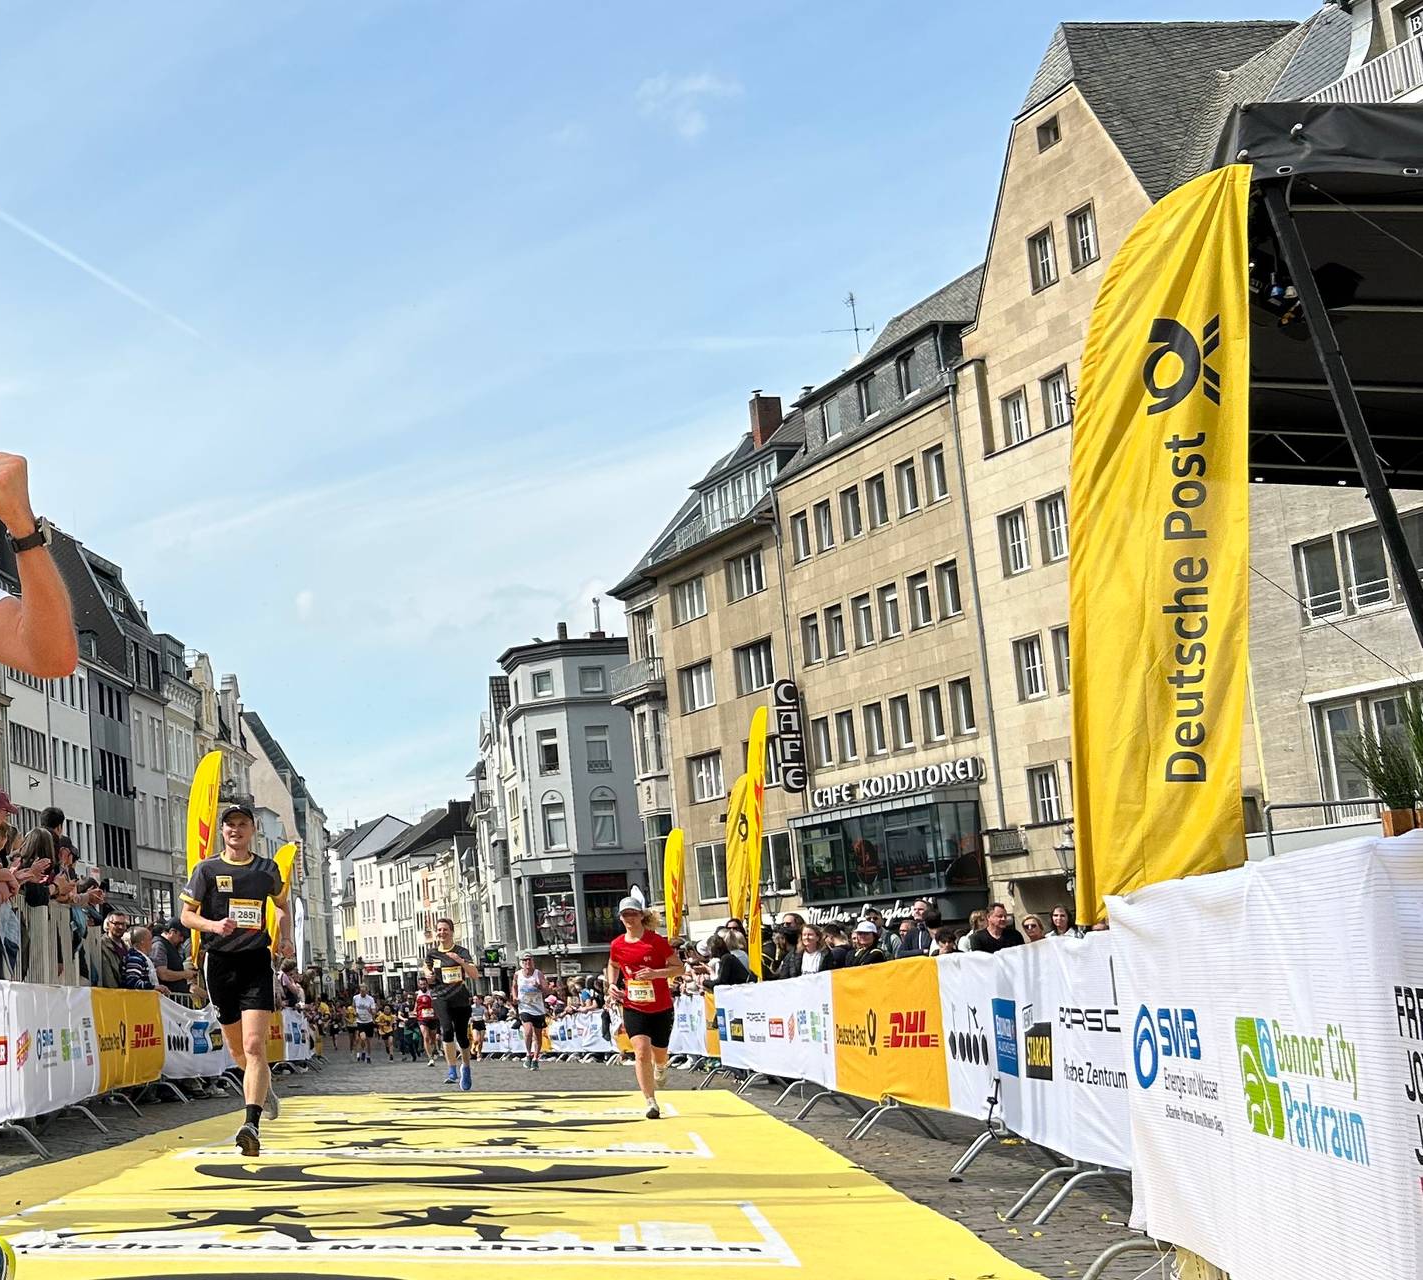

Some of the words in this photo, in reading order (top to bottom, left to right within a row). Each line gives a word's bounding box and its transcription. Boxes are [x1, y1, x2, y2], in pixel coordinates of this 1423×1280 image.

[1163, 431, 1208, 540] Post
[1164, 556, 1210, 784] Deutsche
[777, 682, 806, 789] CAFE
[813, 783, 852, 808] CAFE
[859, 757, 974, 800] KONDITOREI
[237, 910, 256, 920] 2851
[889, 1010, 933, 1048] DHL
[1027, 1036, 1052, 1067] STARCAR
[1157, 1007, 1201, 1060] SWB
[1086, 1062, 1129, 1090] Zentrum
[1271, 1018, 1325, 1078] Bonner
[1327, 1023, 1358, 1101] City
[1282, 1081, 1370, 1167] Parkraum
[198, 1243, 315, 1251] Post
[328, 1243, 595, 1252] Marathon
[611, 1245, 763, 1253] Bonn
